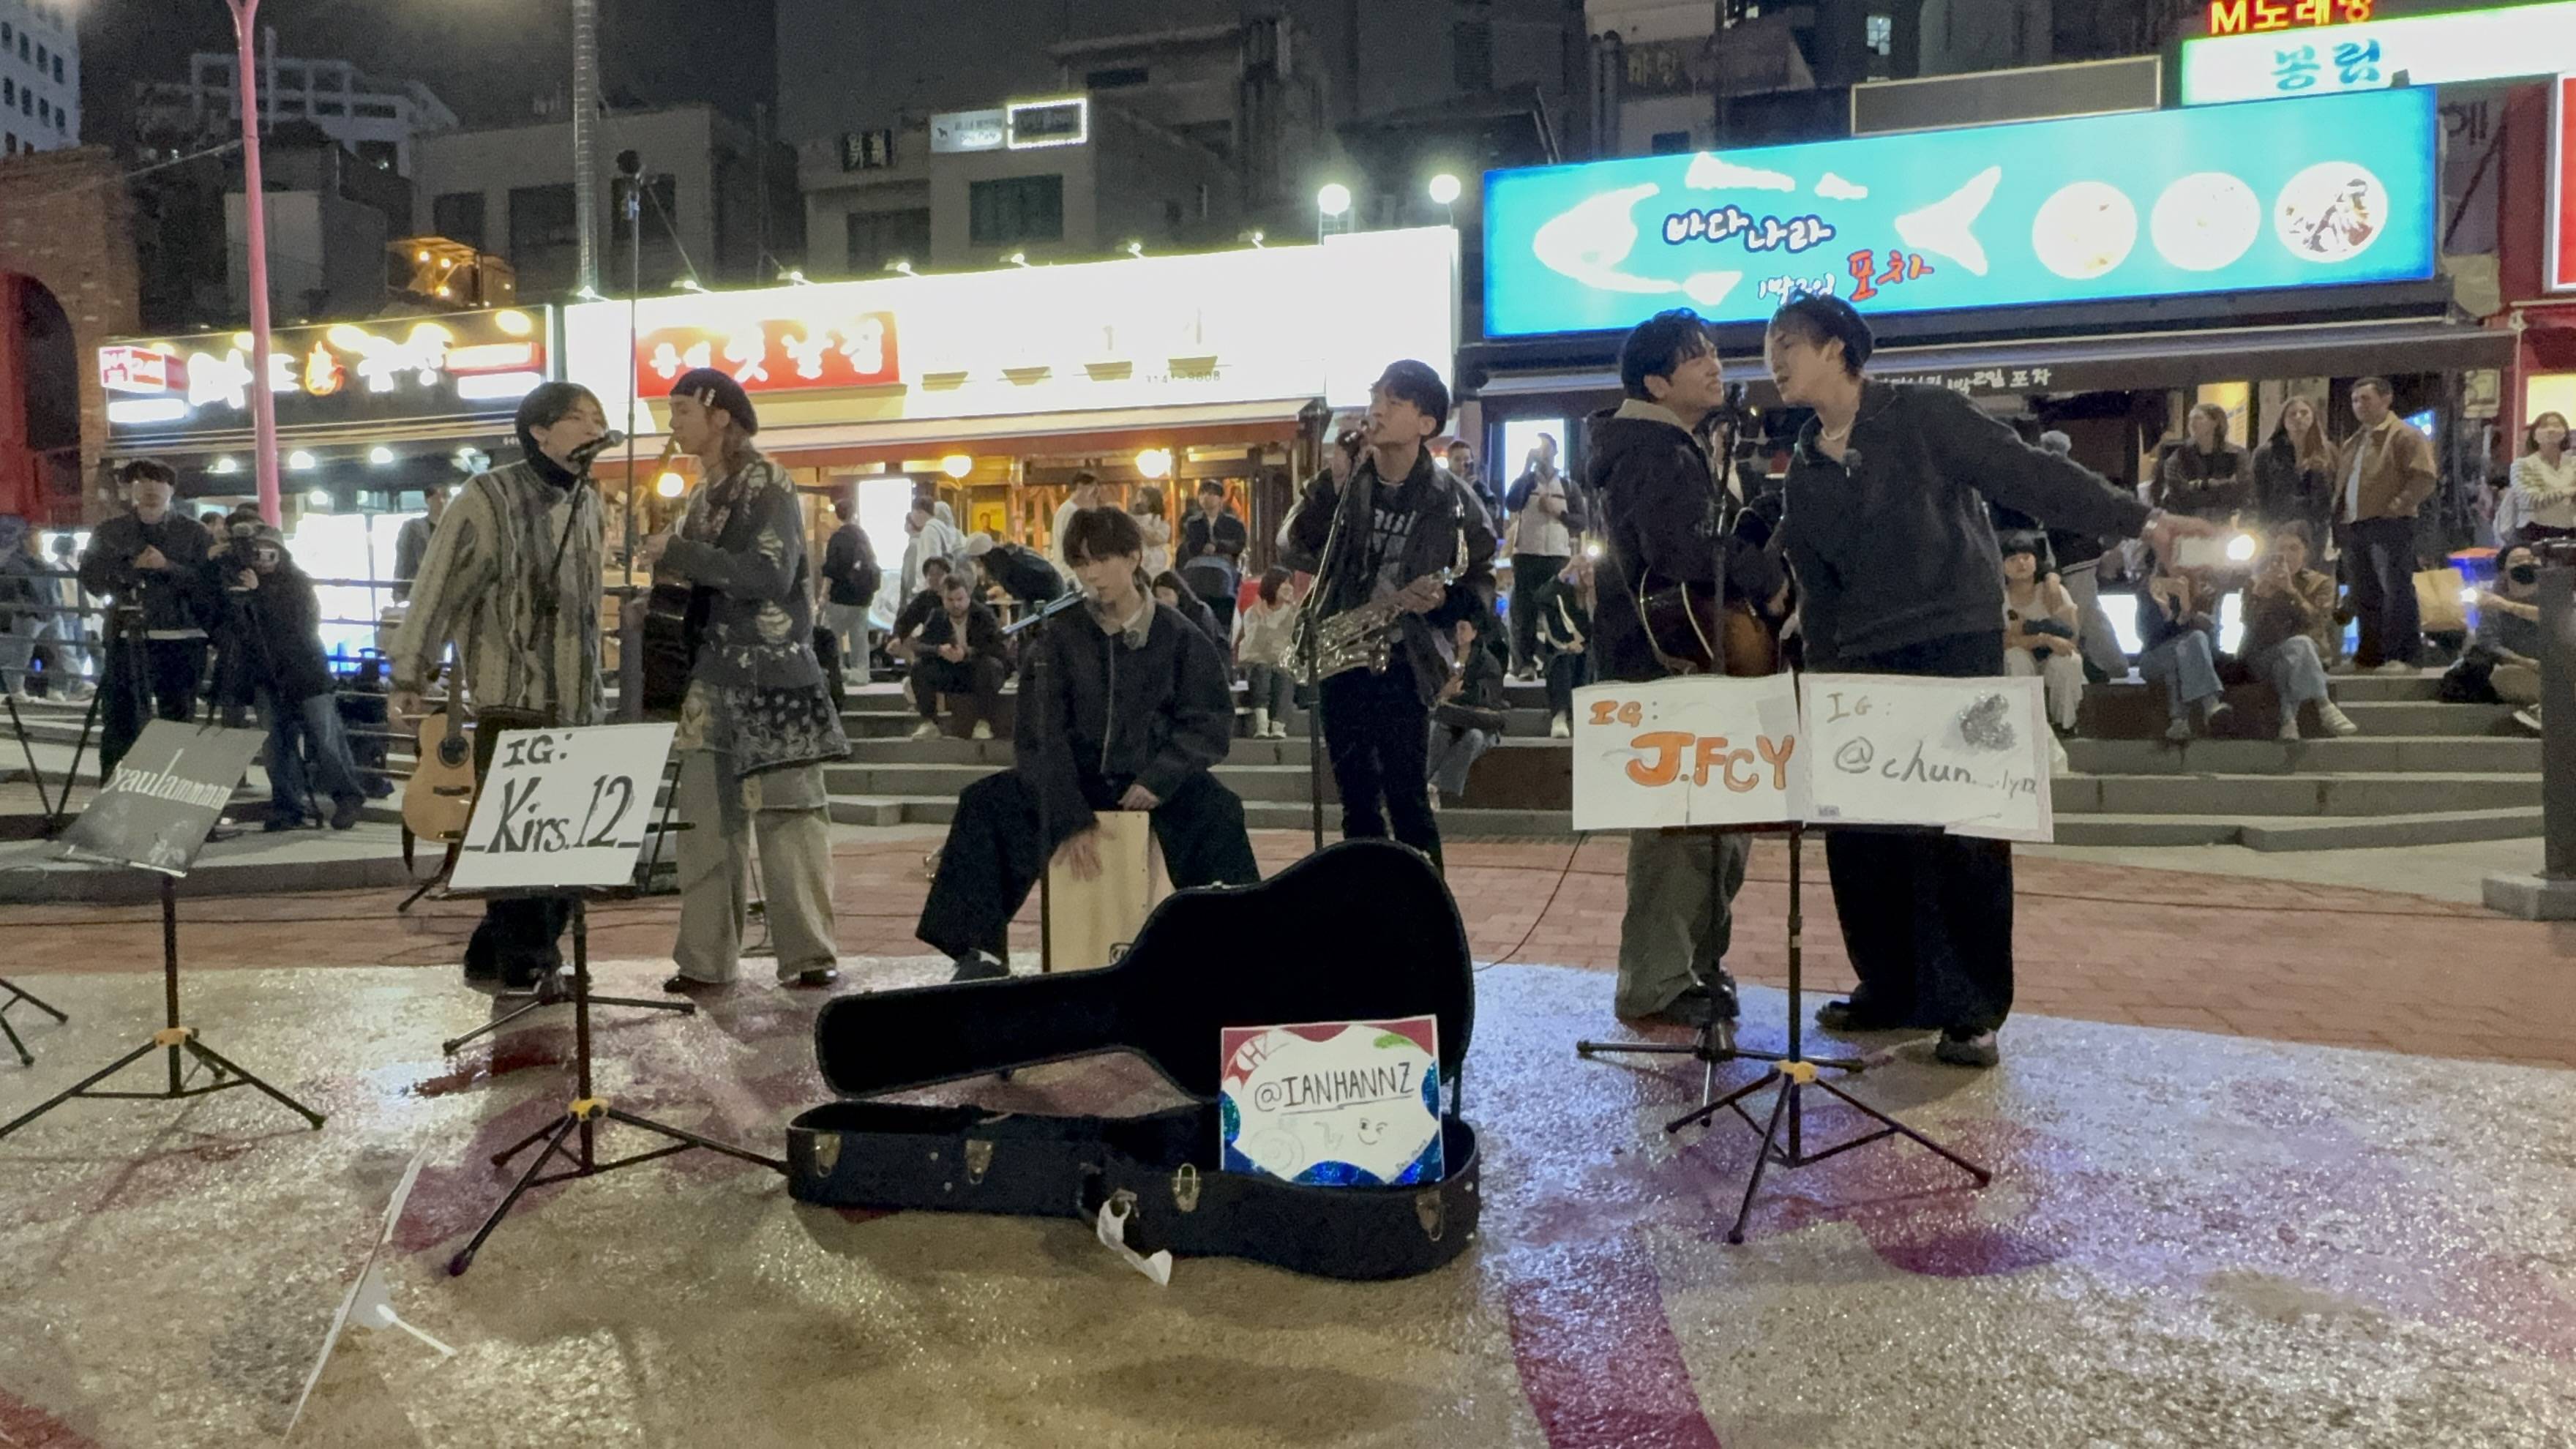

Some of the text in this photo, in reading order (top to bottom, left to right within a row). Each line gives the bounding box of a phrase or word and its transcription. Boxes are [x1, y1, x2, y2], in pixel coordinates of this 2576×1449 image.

[1663, 204, 1836, 253] 바다나라
[1846, 249, 1935, 302] 포차
[501, 733, 573, 768] IG:
[1254, 1062, 1414, 1113] @IANHANNZ
